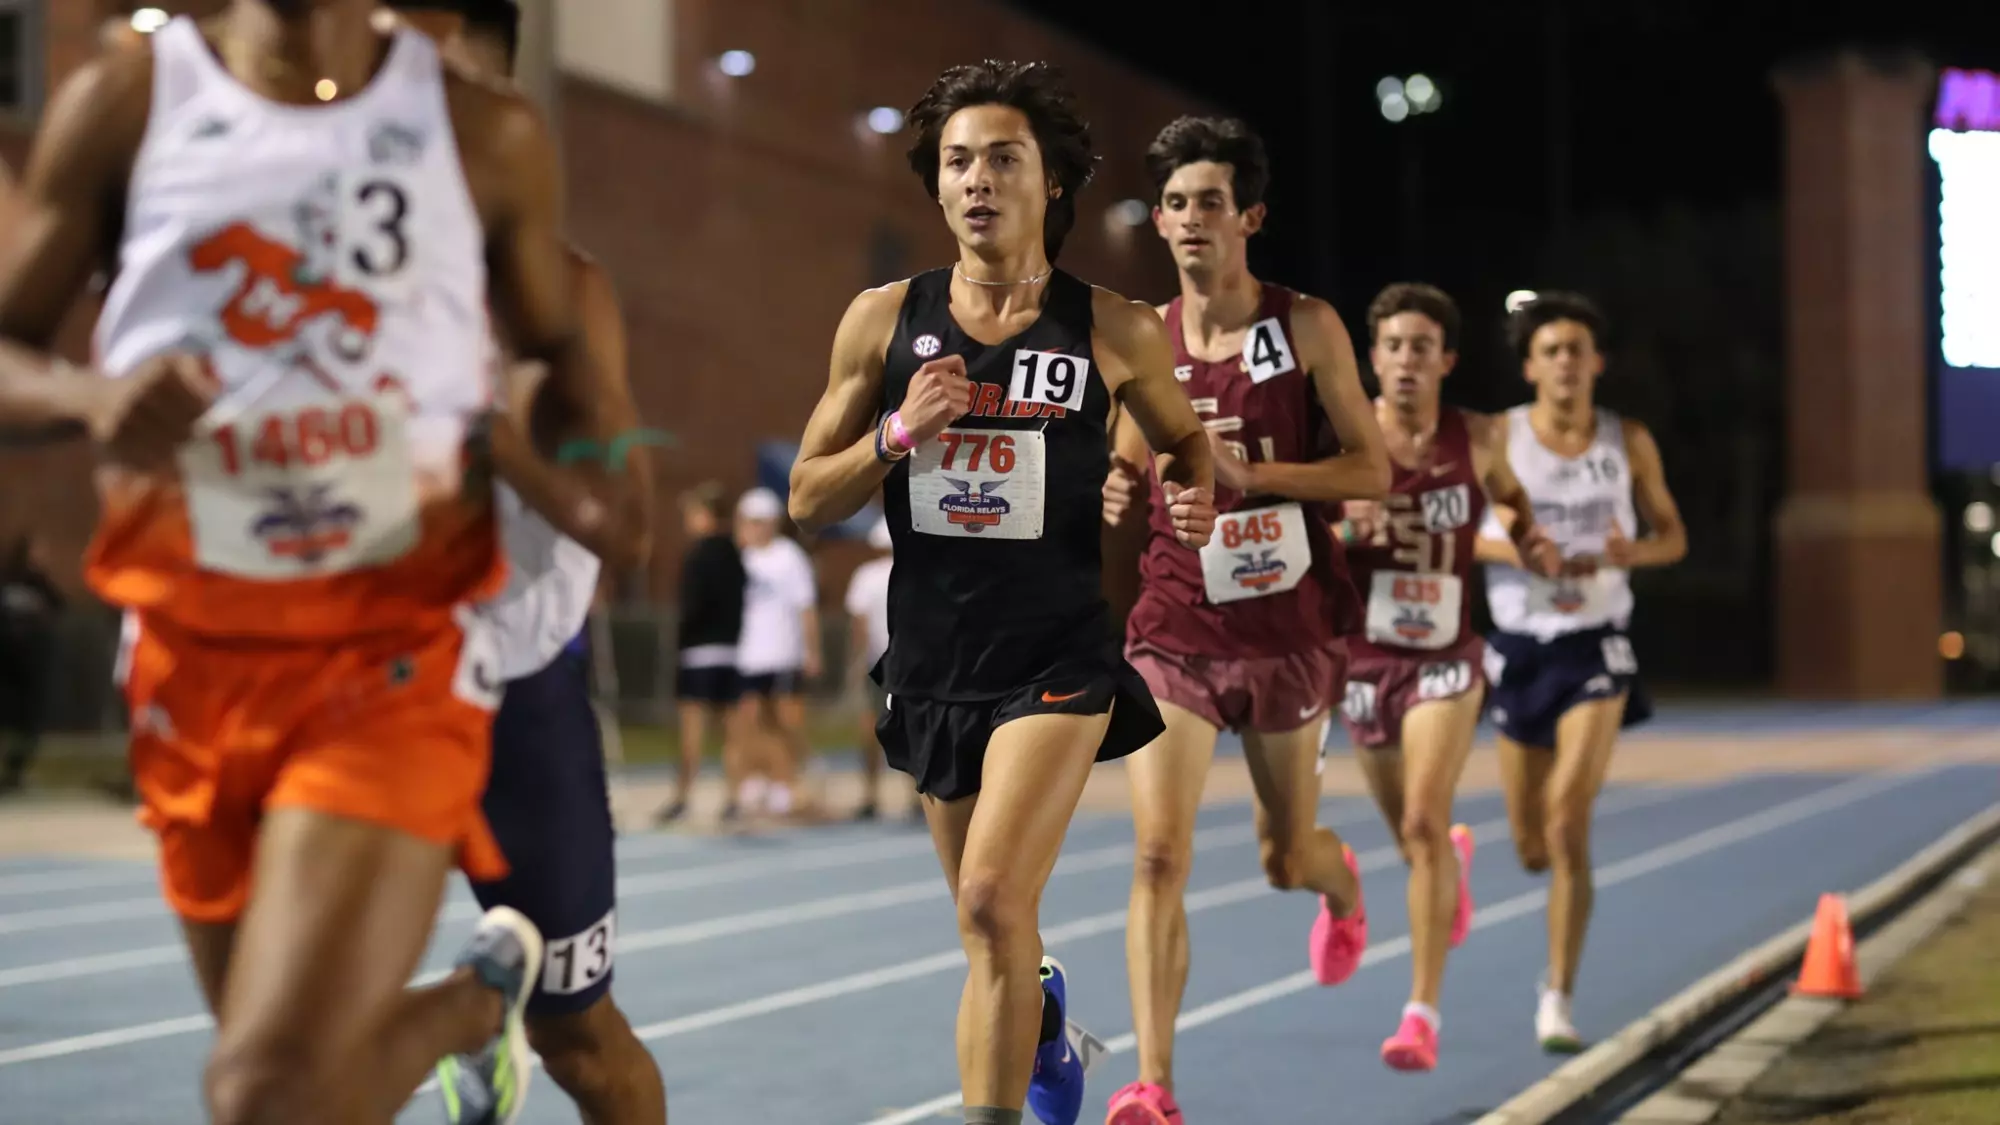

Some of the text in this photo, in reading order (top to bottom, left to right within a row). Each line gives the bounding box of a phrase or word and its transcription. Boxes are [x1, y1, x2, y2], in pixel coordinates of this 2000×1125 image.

[351, 178, 408, 276] 3
[913, 334, 941, 357] SEC
[1251, 325, 1283, 369] 4
[1018, 353, 1077, 405] 19
[212, 402, 381, 476] 1460
[938, 432, 1016, 473] 776
[943, 503, 1005, 514] FLORIDA RELAYS
[1428, 487, 1463, 527] 20
[1221, 510, 1283, 550] 845
[552, 925, 607, 990] 13
